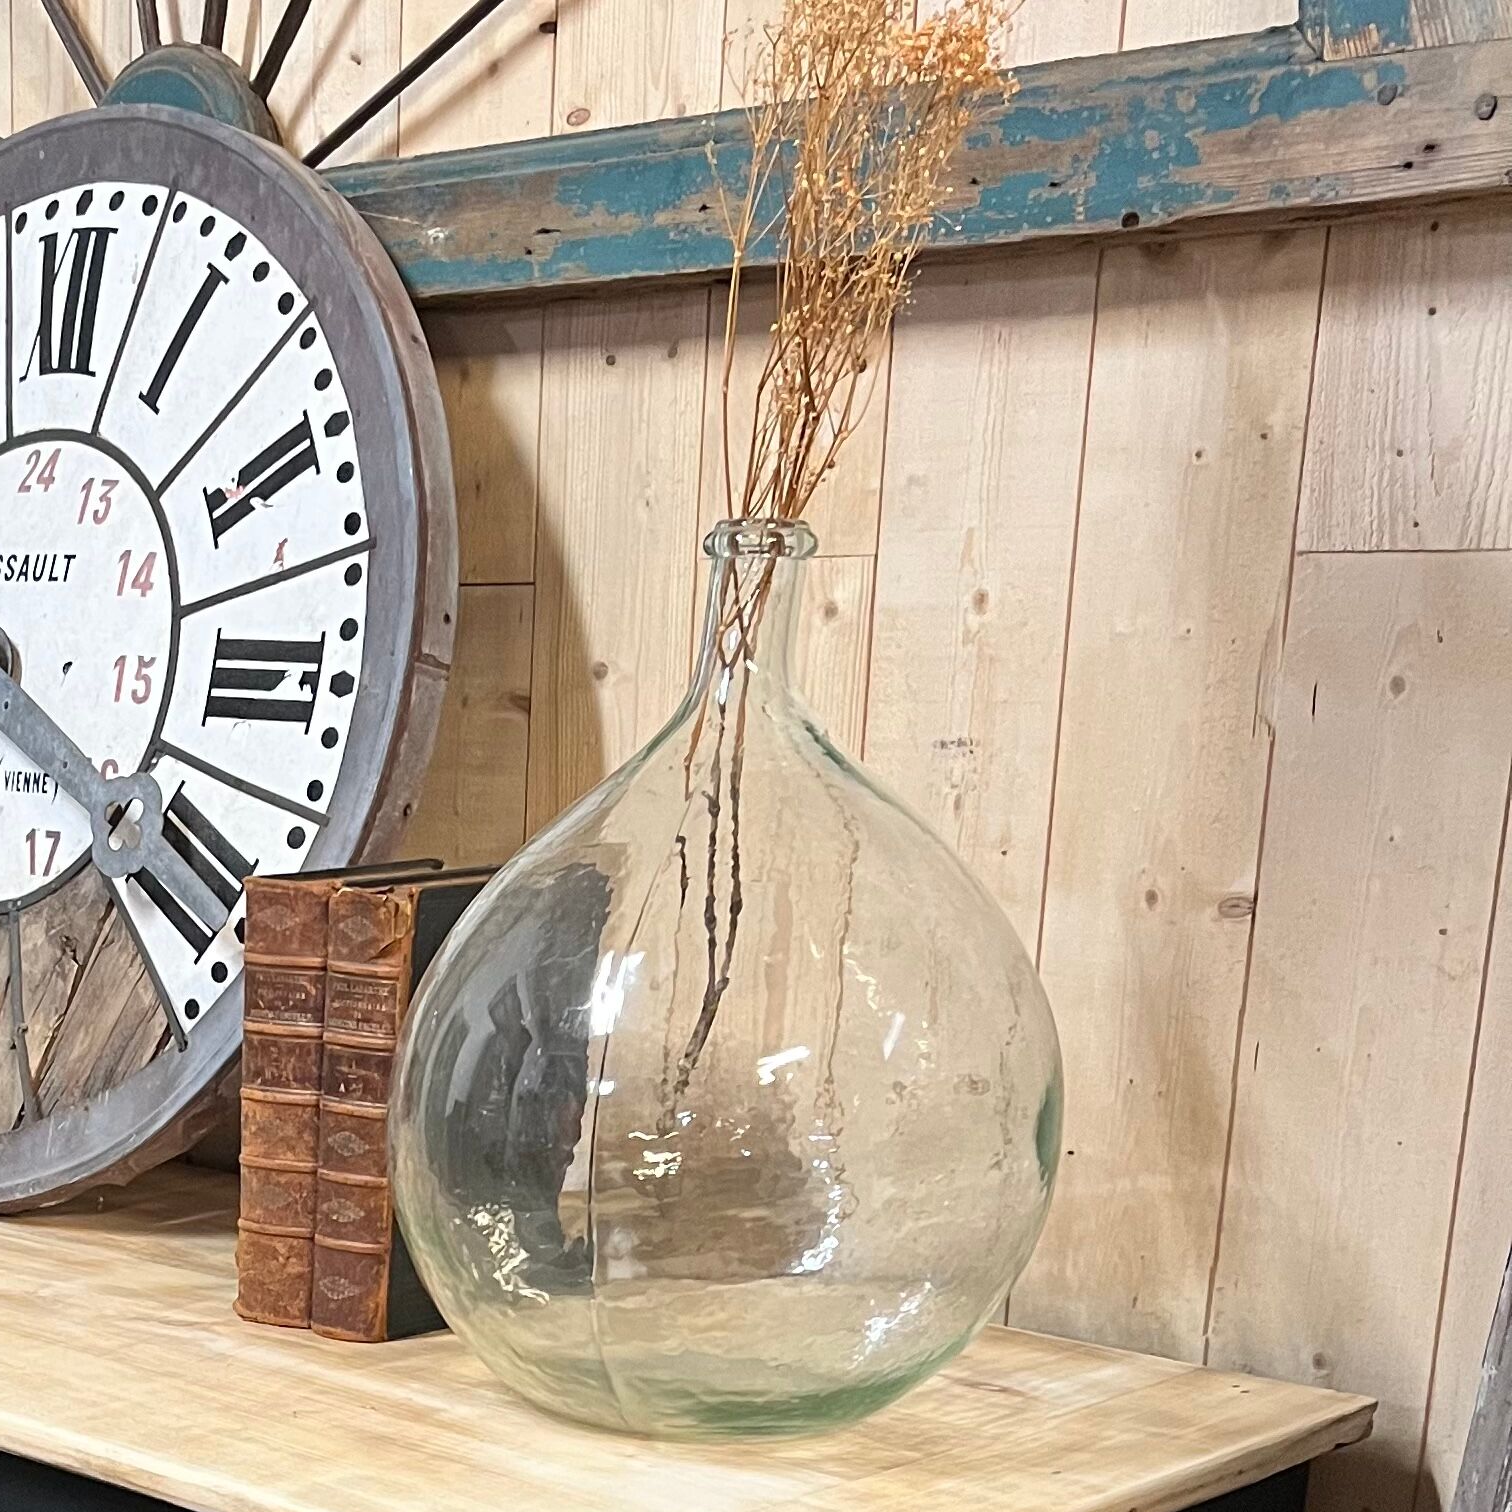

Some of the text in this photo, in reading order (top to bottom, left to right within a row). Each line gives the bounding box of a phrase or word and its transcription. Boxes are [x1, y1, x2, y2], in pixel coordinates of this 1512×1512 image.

[19, 229, 118, 383] XII
[139, 262, 230, 415] I
[17, 448, 62, 493] 24
[203, 410, 320, 549] II
[77, 477, 119, 525] 13
[116, 549, 157, 597] 14
[112, 655, 155, 704] 15
[201, 627, 327, 734] III
[25, 828, 61, 877] 17
